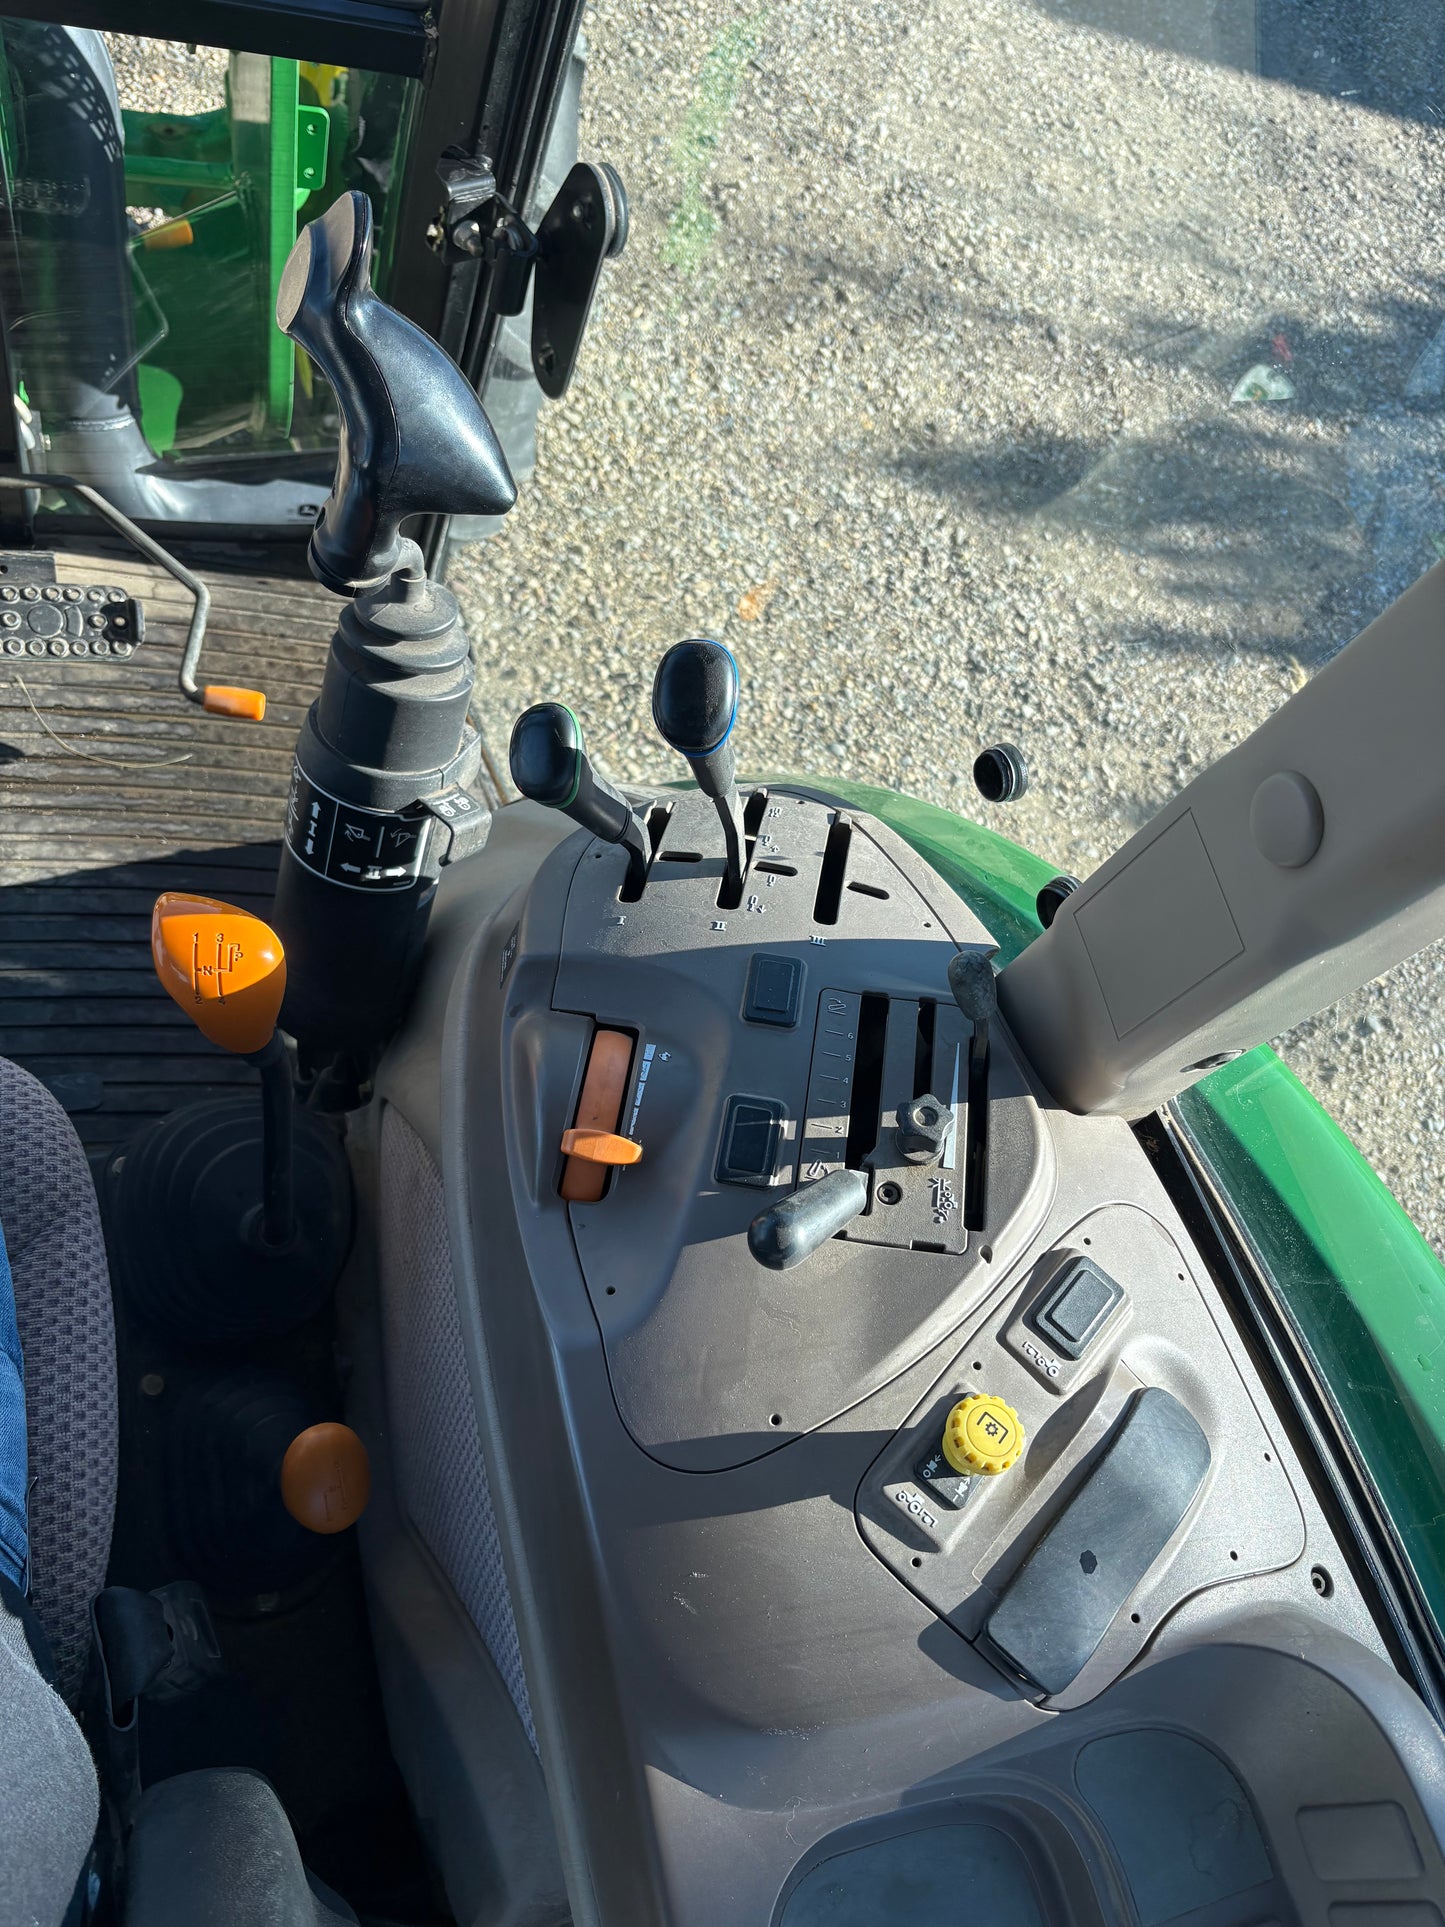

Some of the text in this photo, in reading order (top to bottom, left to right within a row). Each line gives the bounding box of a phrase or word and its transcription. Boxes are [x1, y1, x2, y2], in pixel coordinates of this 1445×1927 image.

[192, 932, 199, 943] 1
[216, 933, 224, 943] 3
[234, 951, 244, 962] P
[202, 965, 213, 976] N
[847, 1031, 854, 1040] 6
[845, 1054, 851, 1062] 5
[842, 1076, 849, 1084] 4
[840, 1100, 847, 1109] 3
[834, 1125, 843, 1135] 2
